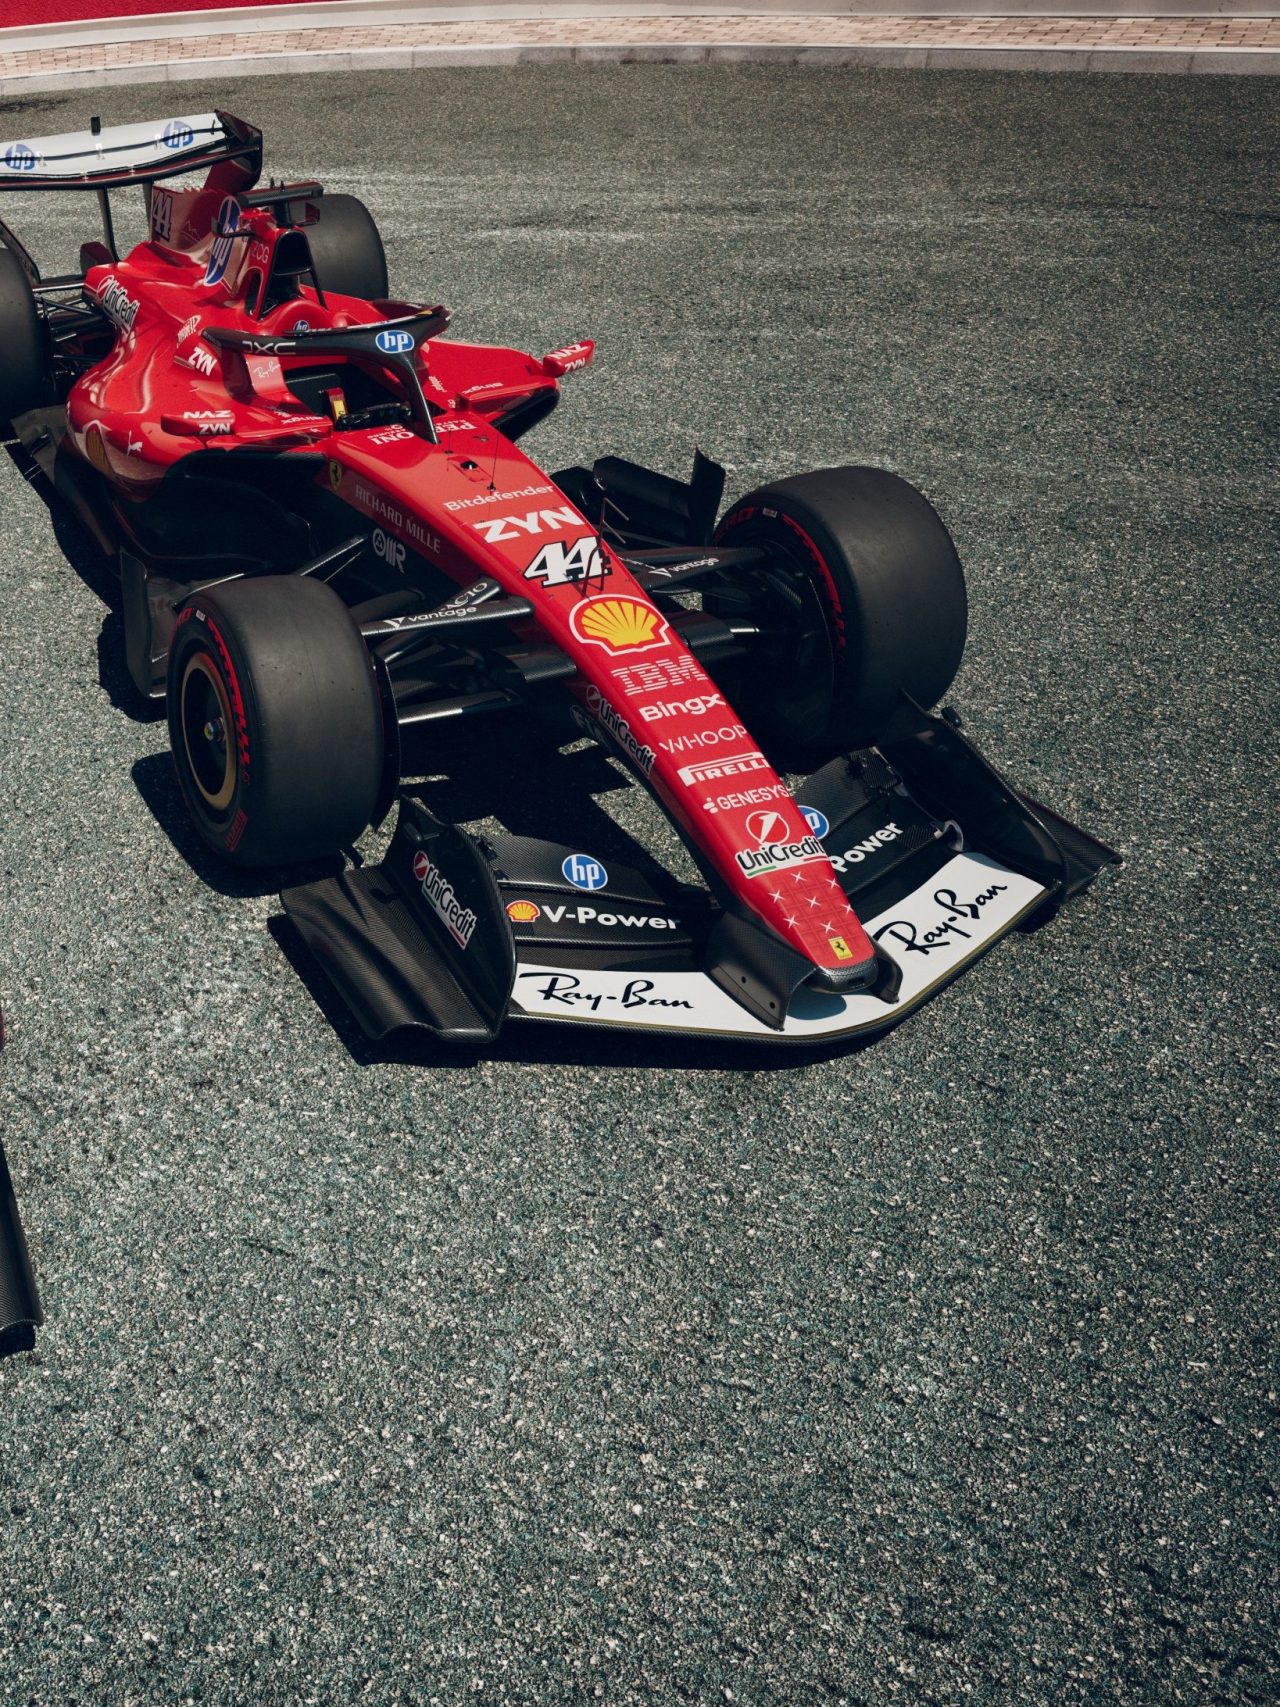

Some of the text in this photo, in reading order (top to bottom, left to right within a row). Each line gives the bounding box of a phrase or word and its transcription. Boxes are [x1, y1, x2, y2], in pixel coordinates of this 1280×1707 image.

[166, 121, 191, 148] hp
[7, 144, 35, 170] hp
[152, 189, 172, 242] 44
[380, 331, 412, 353] hp
[188, 346, 218, 376] ZYN
[443, 485, 554, 511] Bitdefender
[355, 485, 441, 554] RICHARD MILLE
[472, 506, 585, 543] ZYN
[523, 535, 613, 588] 44
[407, 606, 477, 621] vantage
[611, 655, 708, 696] IBM
[600, 699, 656, 773] UniCredit
[658, 725, 748, 753] WHOOP
[677, 752, 771, 786] PIRELLI
[716, 784, 791, 810] GENESYS
[736, 837, 825, 870] UniCredit
[827, 822, 905, 874] Power
[567, 854, 602, 890] hp
[424, 863, 478, 942] UniCredit
[541, 905, 677, 930] V-Power
